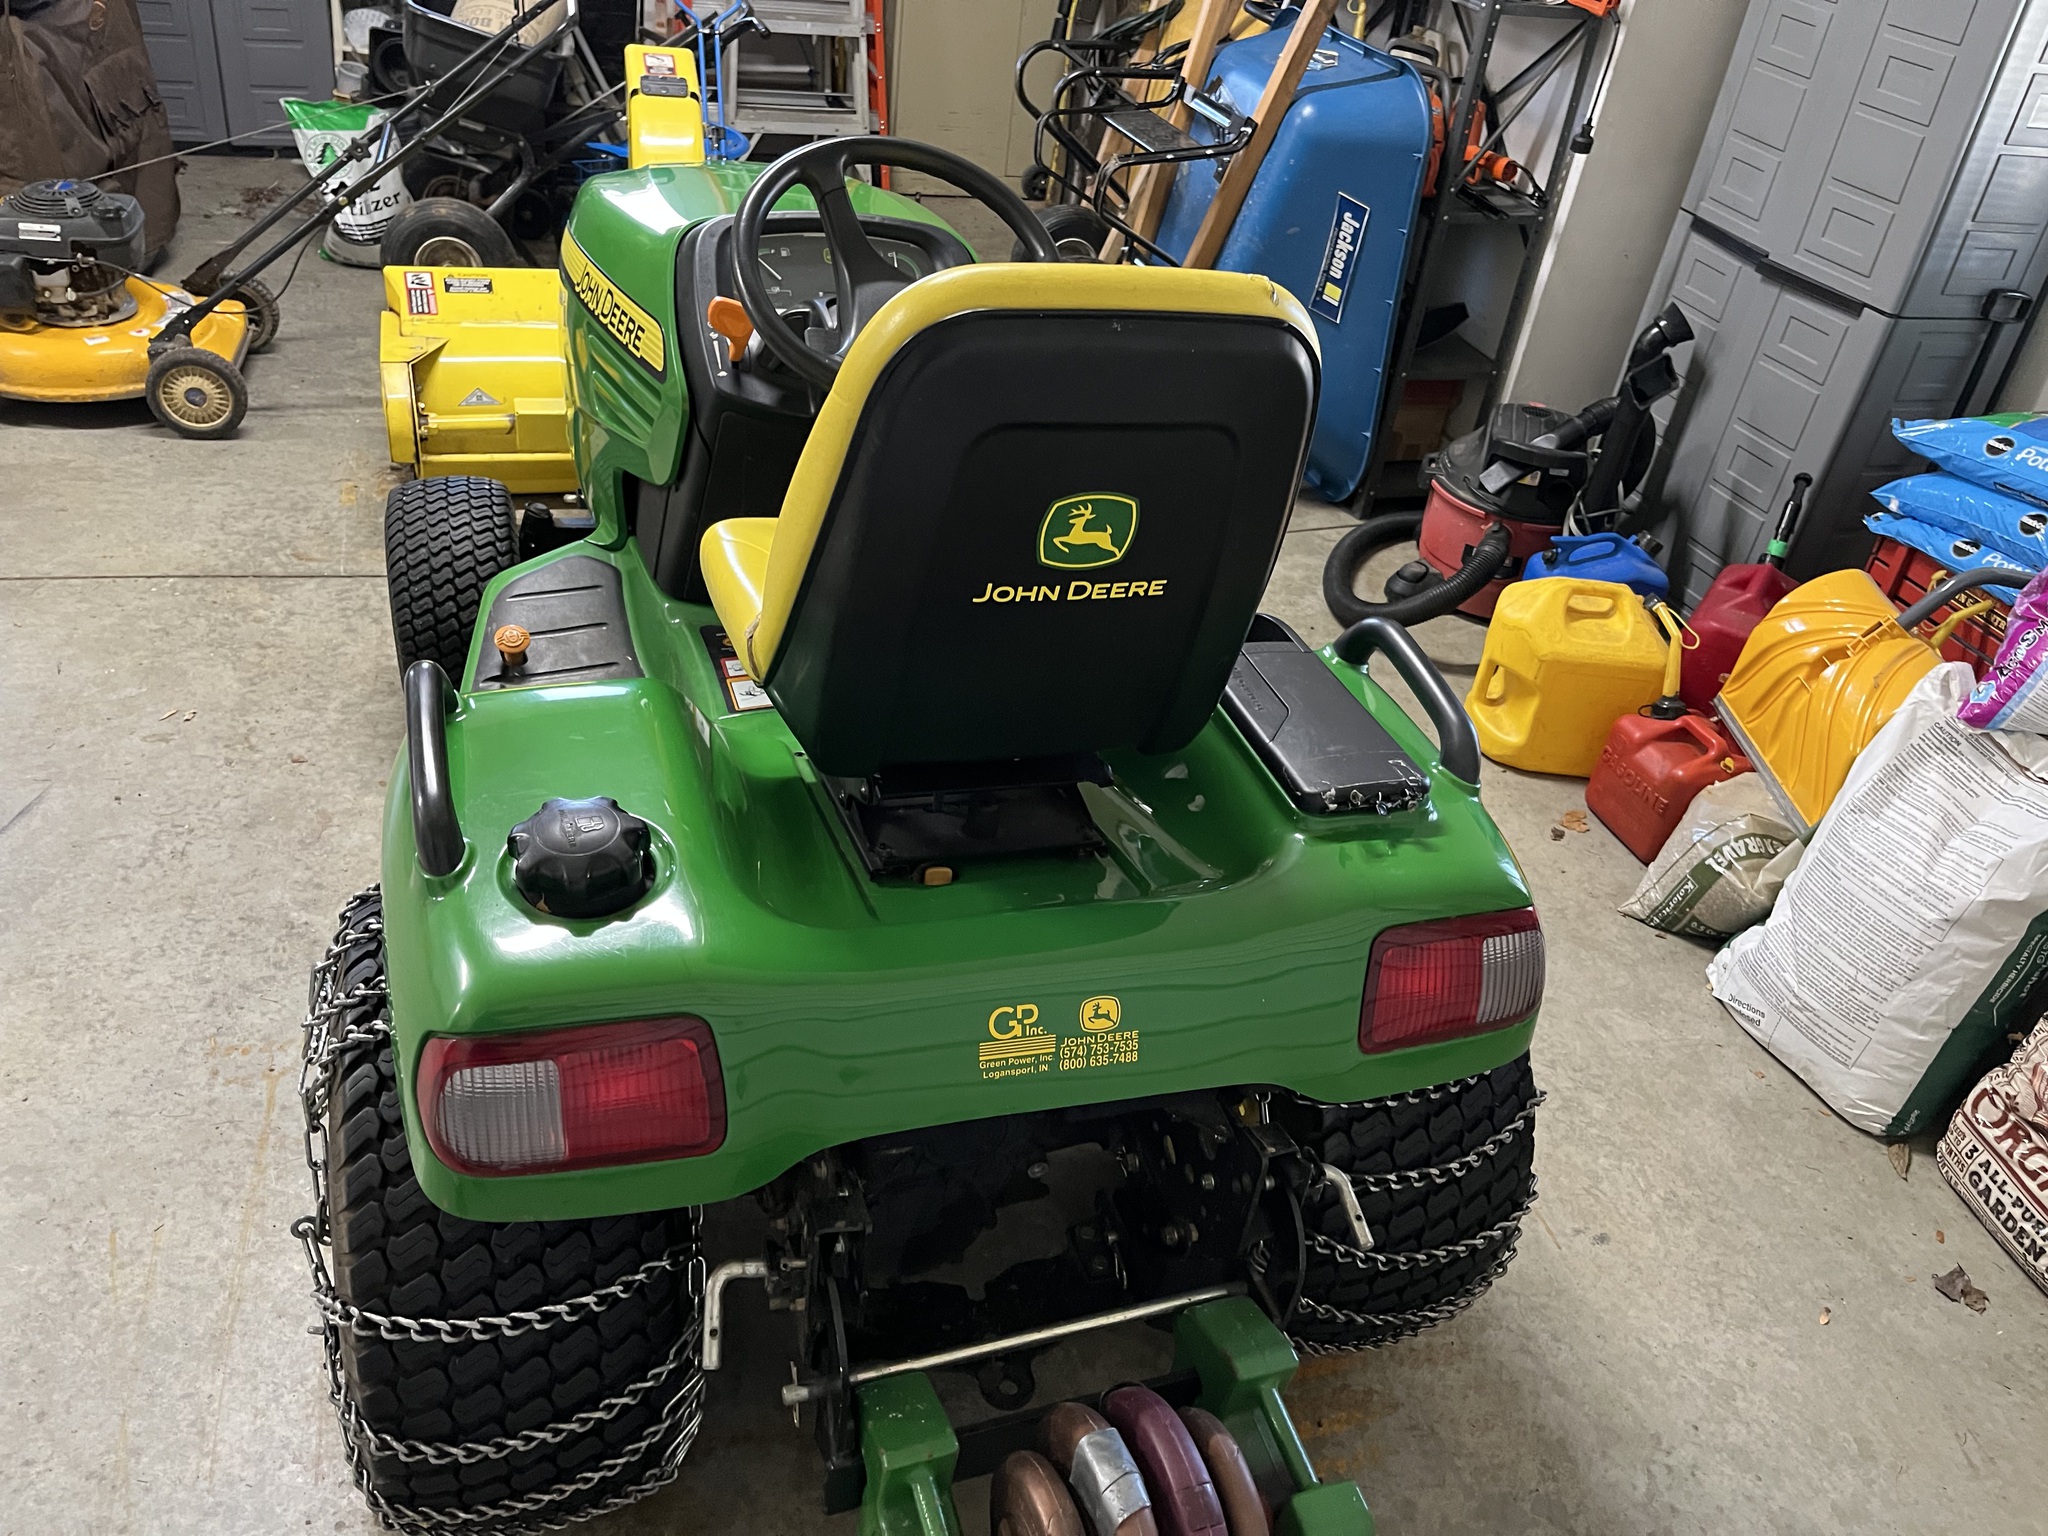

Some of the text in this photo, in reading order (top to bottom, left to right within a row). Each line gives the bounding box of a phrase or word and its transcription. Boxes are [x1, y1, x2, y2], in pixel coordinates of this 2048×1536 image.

[1329, 211, 1360, 280] Jackson
[574, 263, 646, 352] JOHN DEERE
[972, 579, 1168, 603] JOHN DEERE
[1934, 721, 1962, 747] CAUTION
[1704, 836, 1767, 873] GRAVEL
[1989, 933, 2042, 1004] SPECIALTY HERBICIDE
[1728, 993, 1766, 1019] Directions
[988, 1003, 1048, 1040] GP Inc.
[1059, 1039, 1139, 1060] (574) 753-7535
[1060, 1030, 1139, 1047] JOHN DEERE
[979, 1058, 1006, 1070] Green
[1008, 1055, 1037, 1067] Power,
[1059, 1051, 1138, 1071] (800) 635-7488
[1965, 1144, 1980, 1161] 3
[1968, 1170, 2047, 1263] GARDEN
